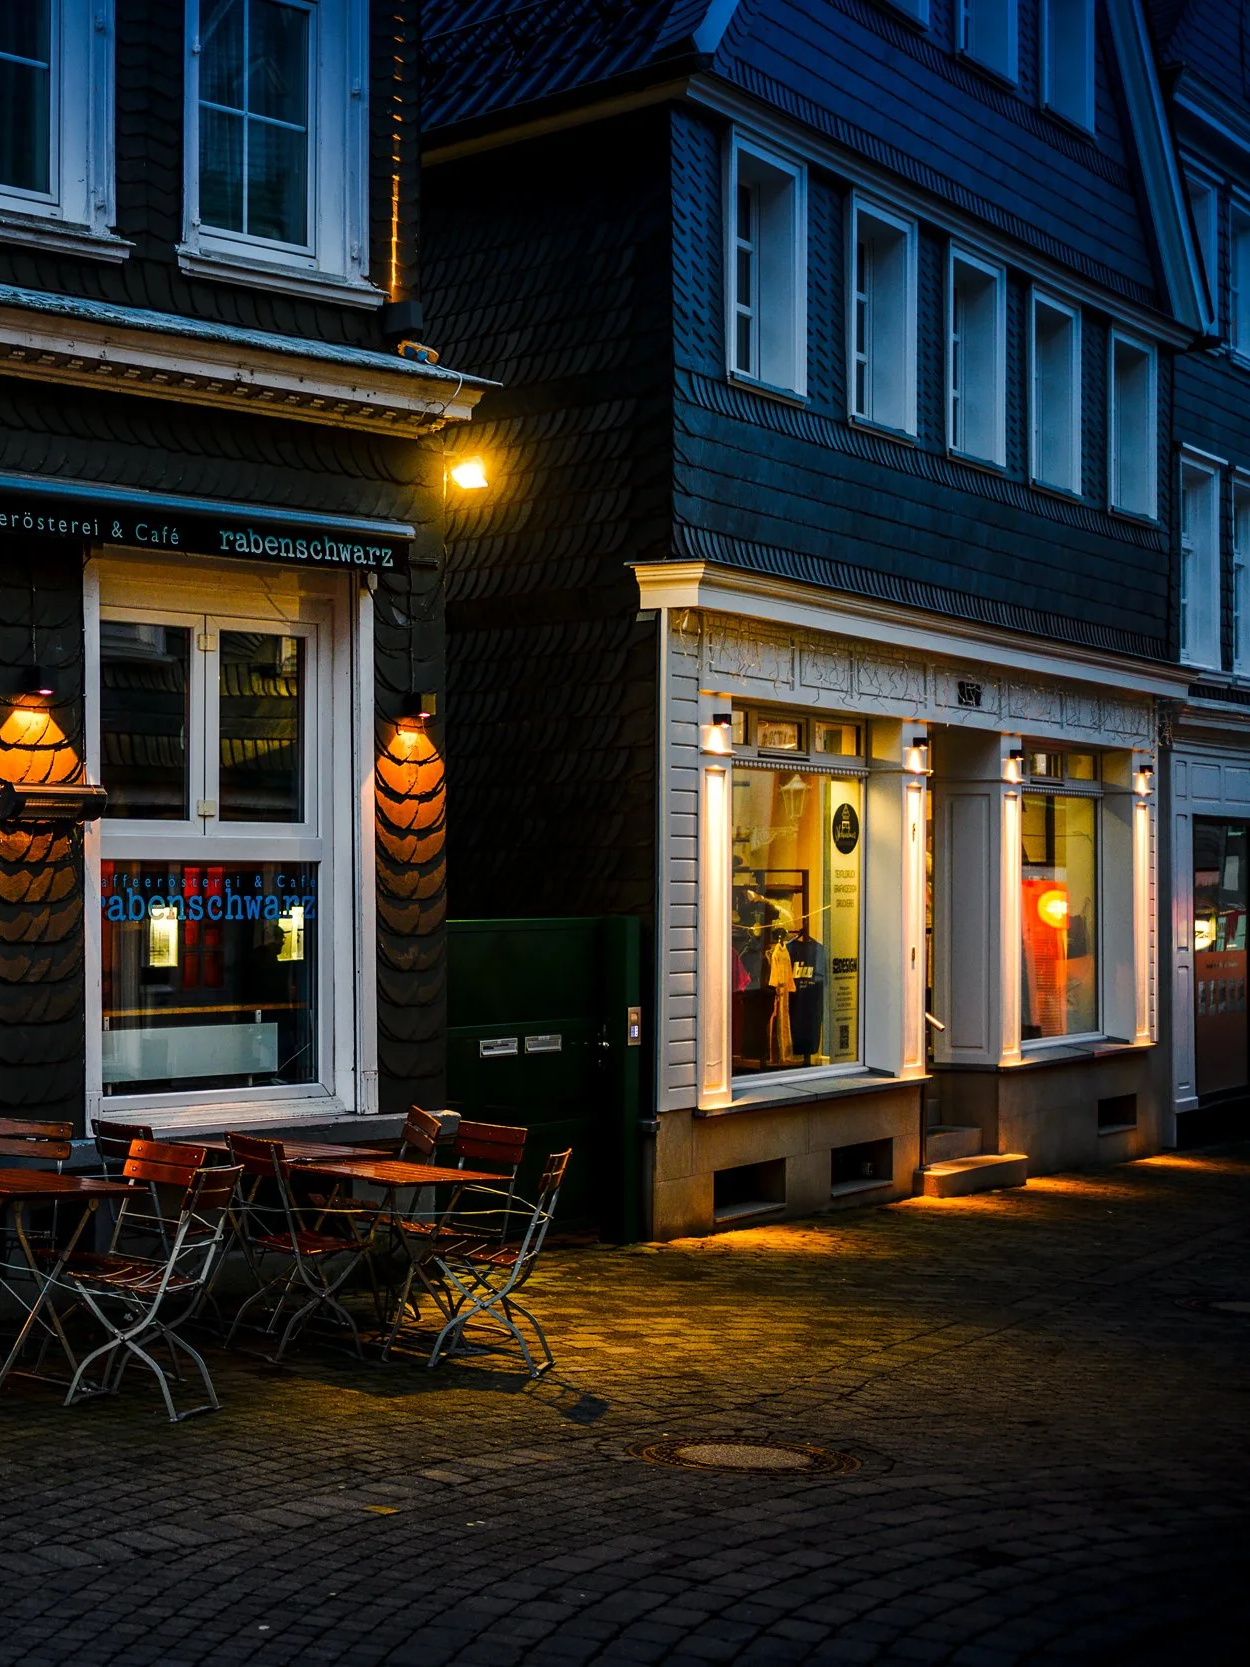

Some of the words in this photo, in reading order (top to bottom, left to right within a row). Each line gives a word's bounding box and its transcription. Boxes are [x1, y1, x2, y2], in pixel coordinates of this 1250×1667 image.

[111, 519, 125, 539] &
[134, 522, 180, 546] Café
[219, 528, 395, 568] rabenschwarz
[101, 873, 241, 888] affeerösterei
[253, 875, 263, 888] &
[101, 887, 316, 921] abenschwarz
